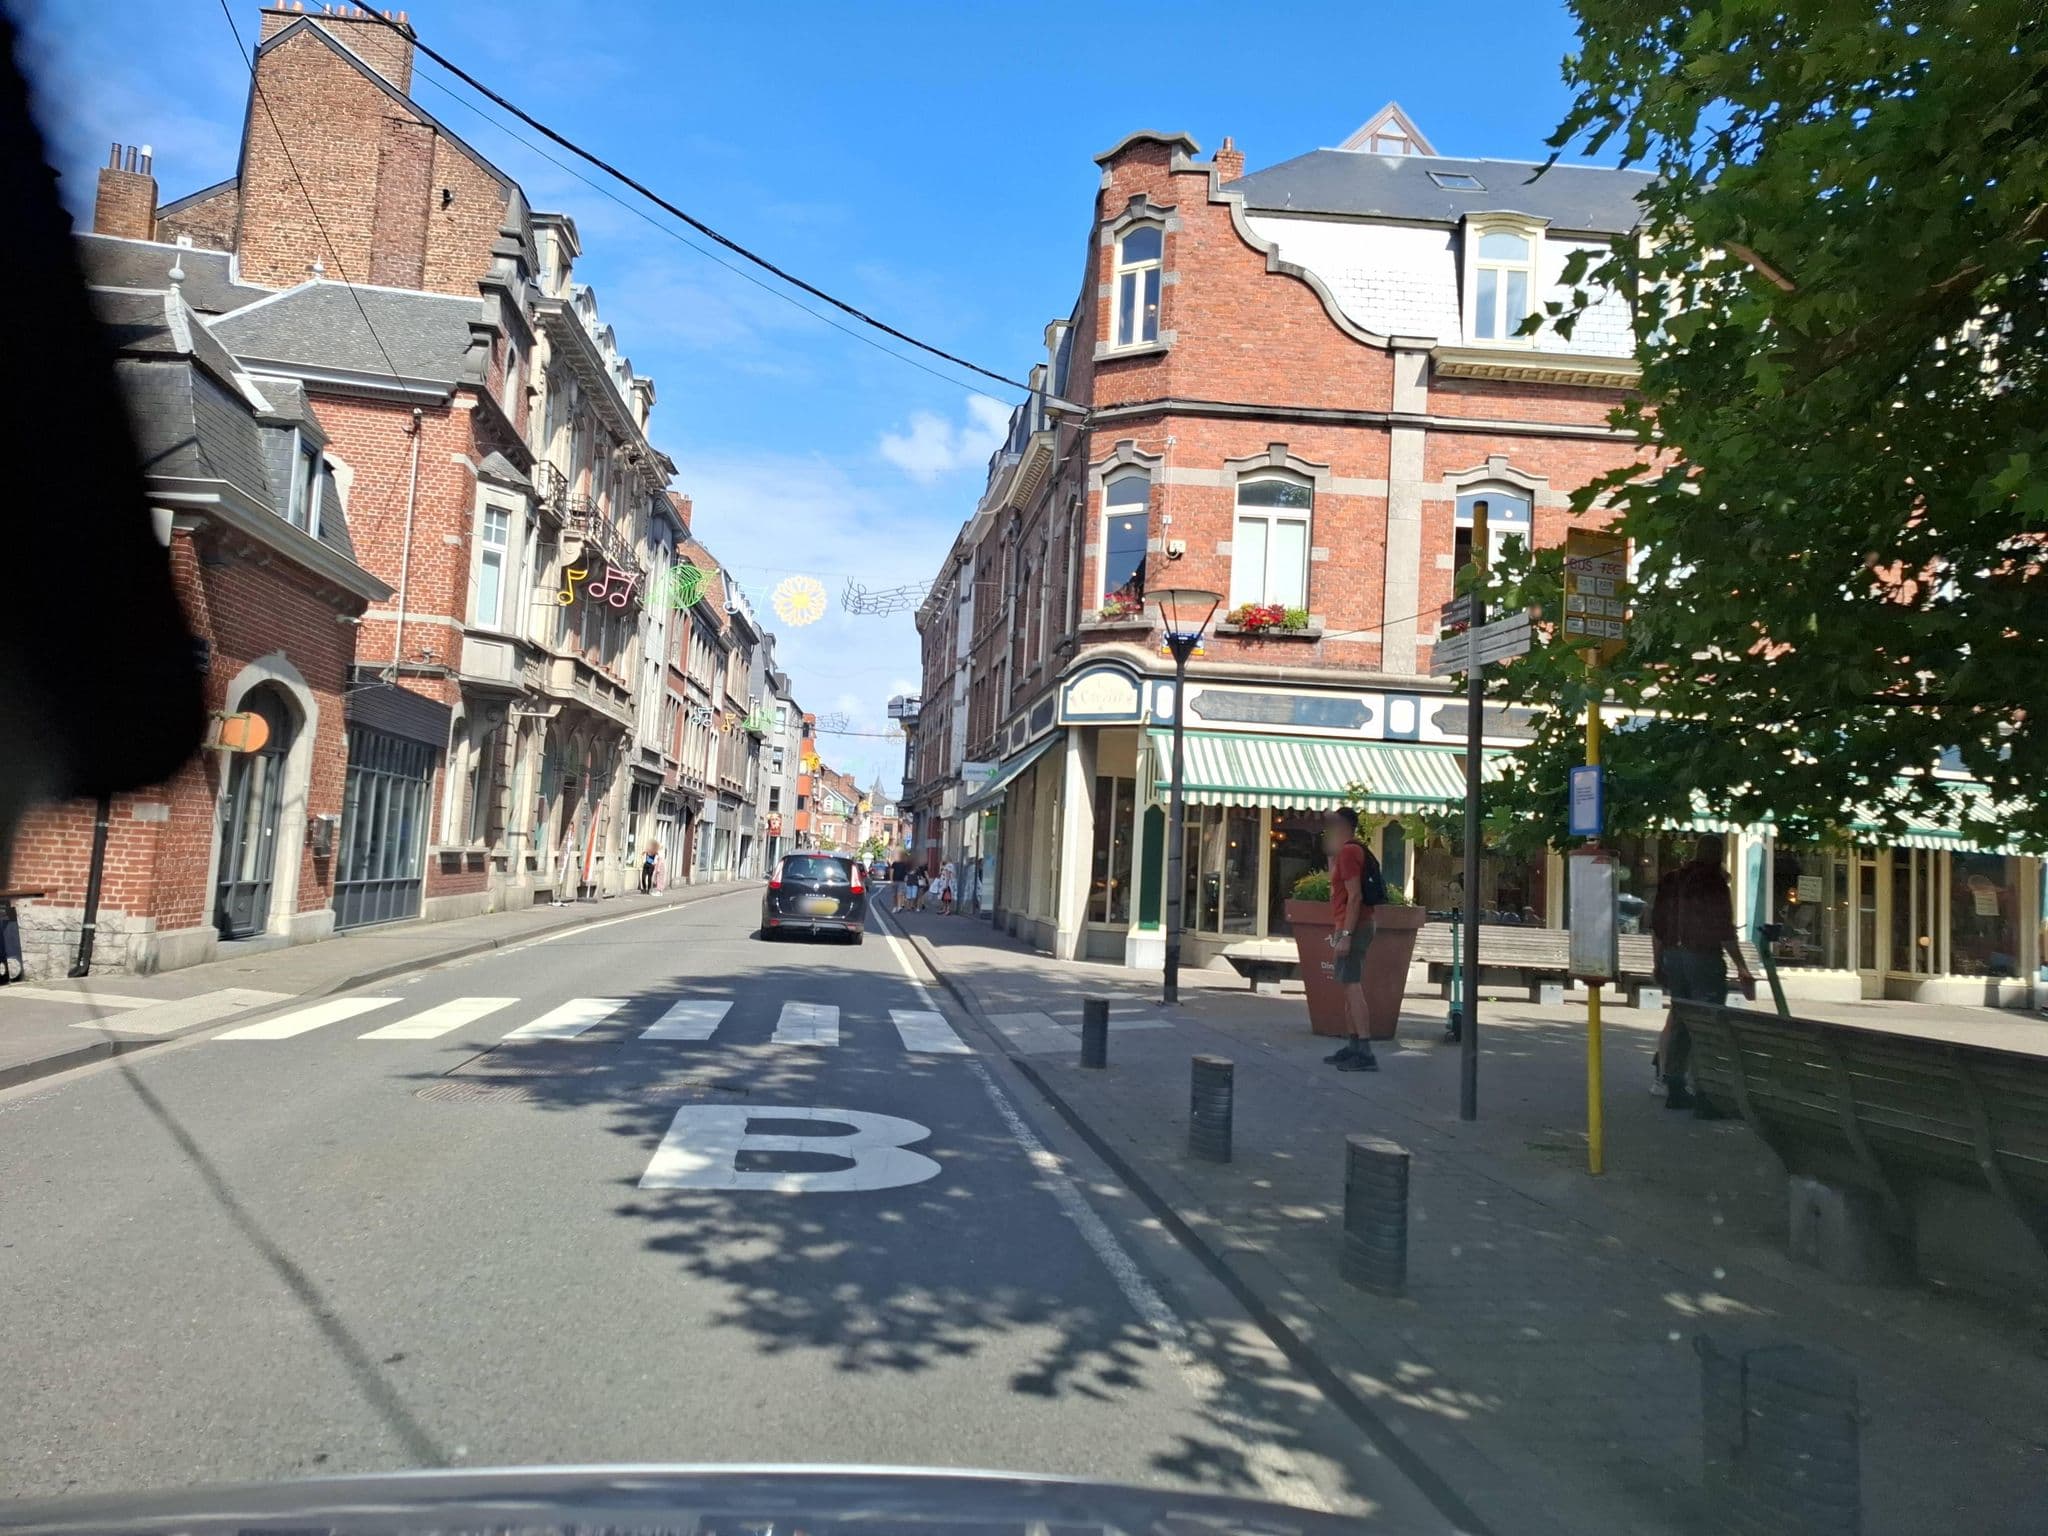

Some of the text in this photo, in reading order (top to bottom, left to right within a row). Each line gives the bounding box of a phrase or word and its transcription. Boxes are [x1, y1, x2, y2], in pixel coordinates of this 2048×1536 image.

[1569, 558, 1625, 576] BUS TEC
[638, 1105, 942, 1192] B
